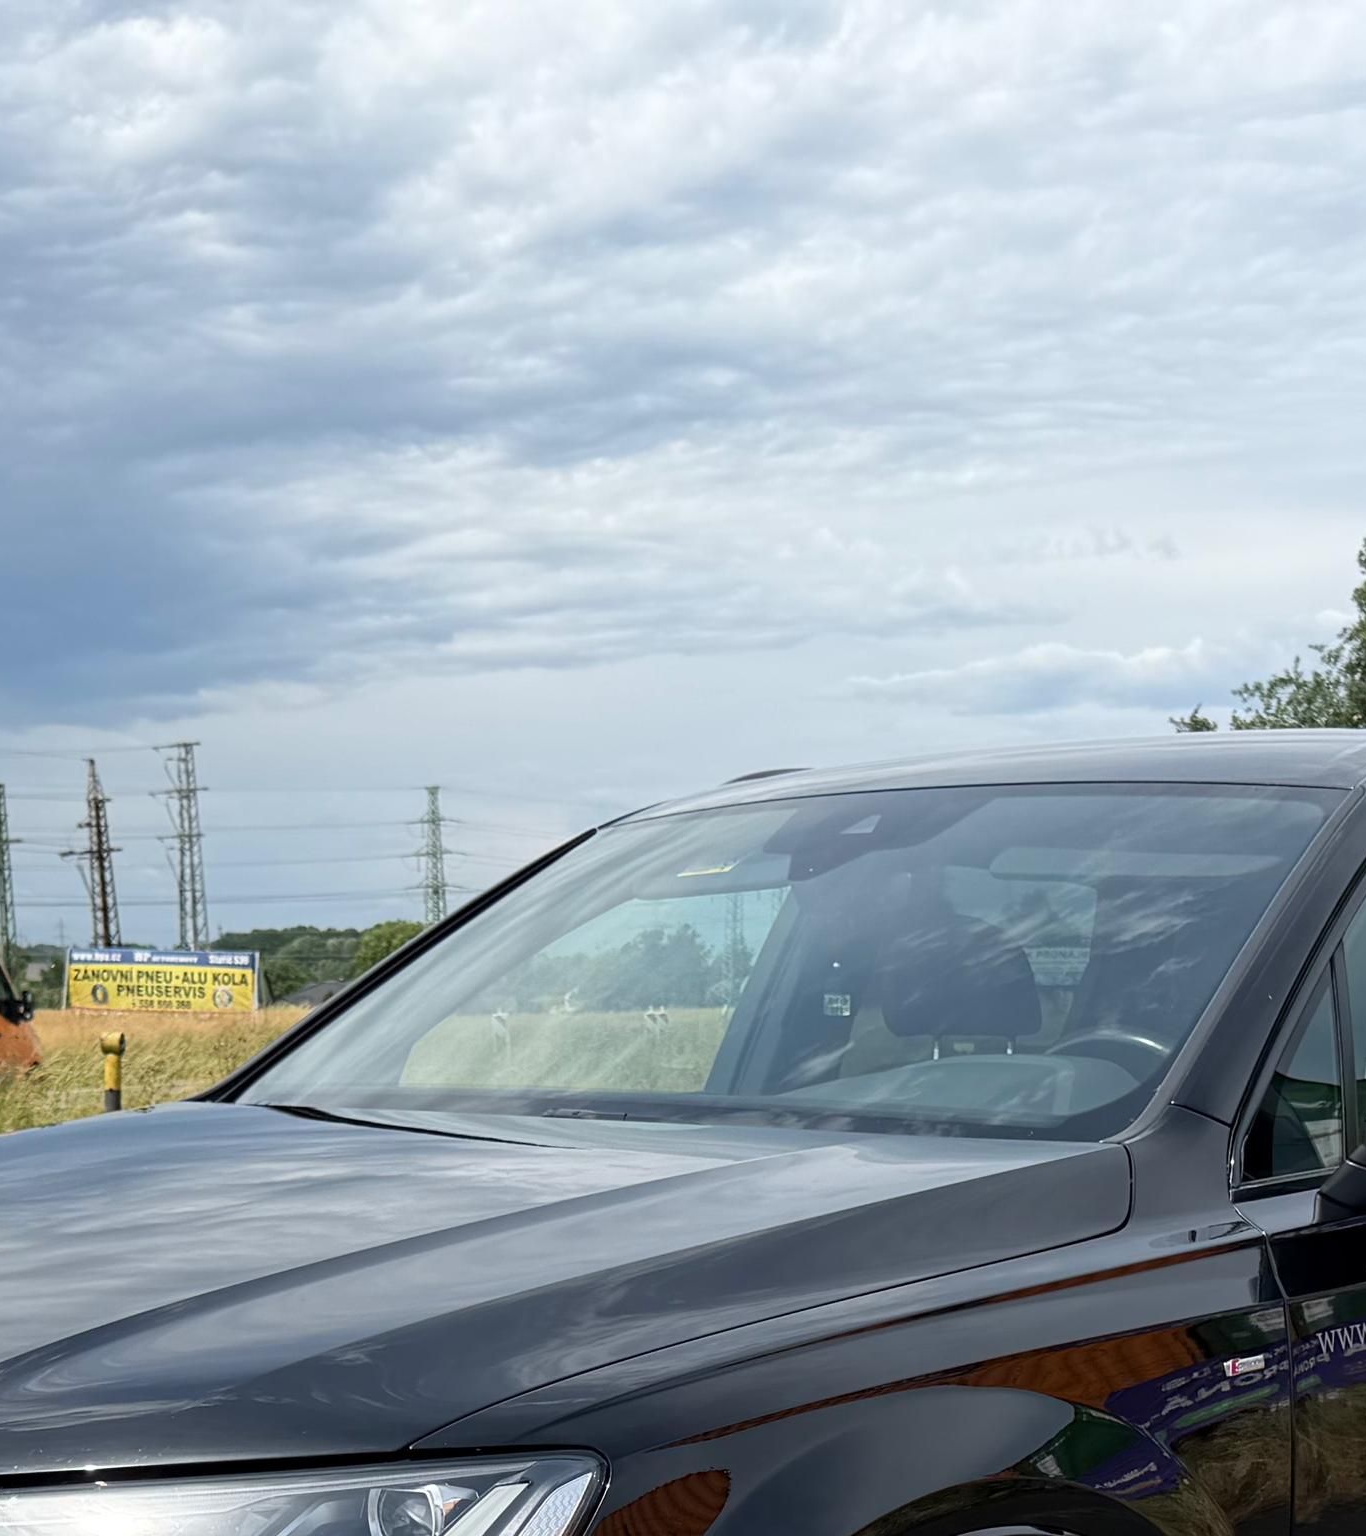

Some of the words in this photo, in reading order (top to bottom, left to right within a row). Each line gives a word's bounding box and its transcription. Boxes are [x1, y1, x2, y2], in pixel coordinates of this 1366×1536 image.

[73, 967, 133, 982] ZÁNOVNÍ
[136, 970, 173, 984] PNEU
[181, 971, 208, 985] ALU
[212, 972, 249, 987] KOLA
[116, 984, 206, 999] PNEUSERVIS
